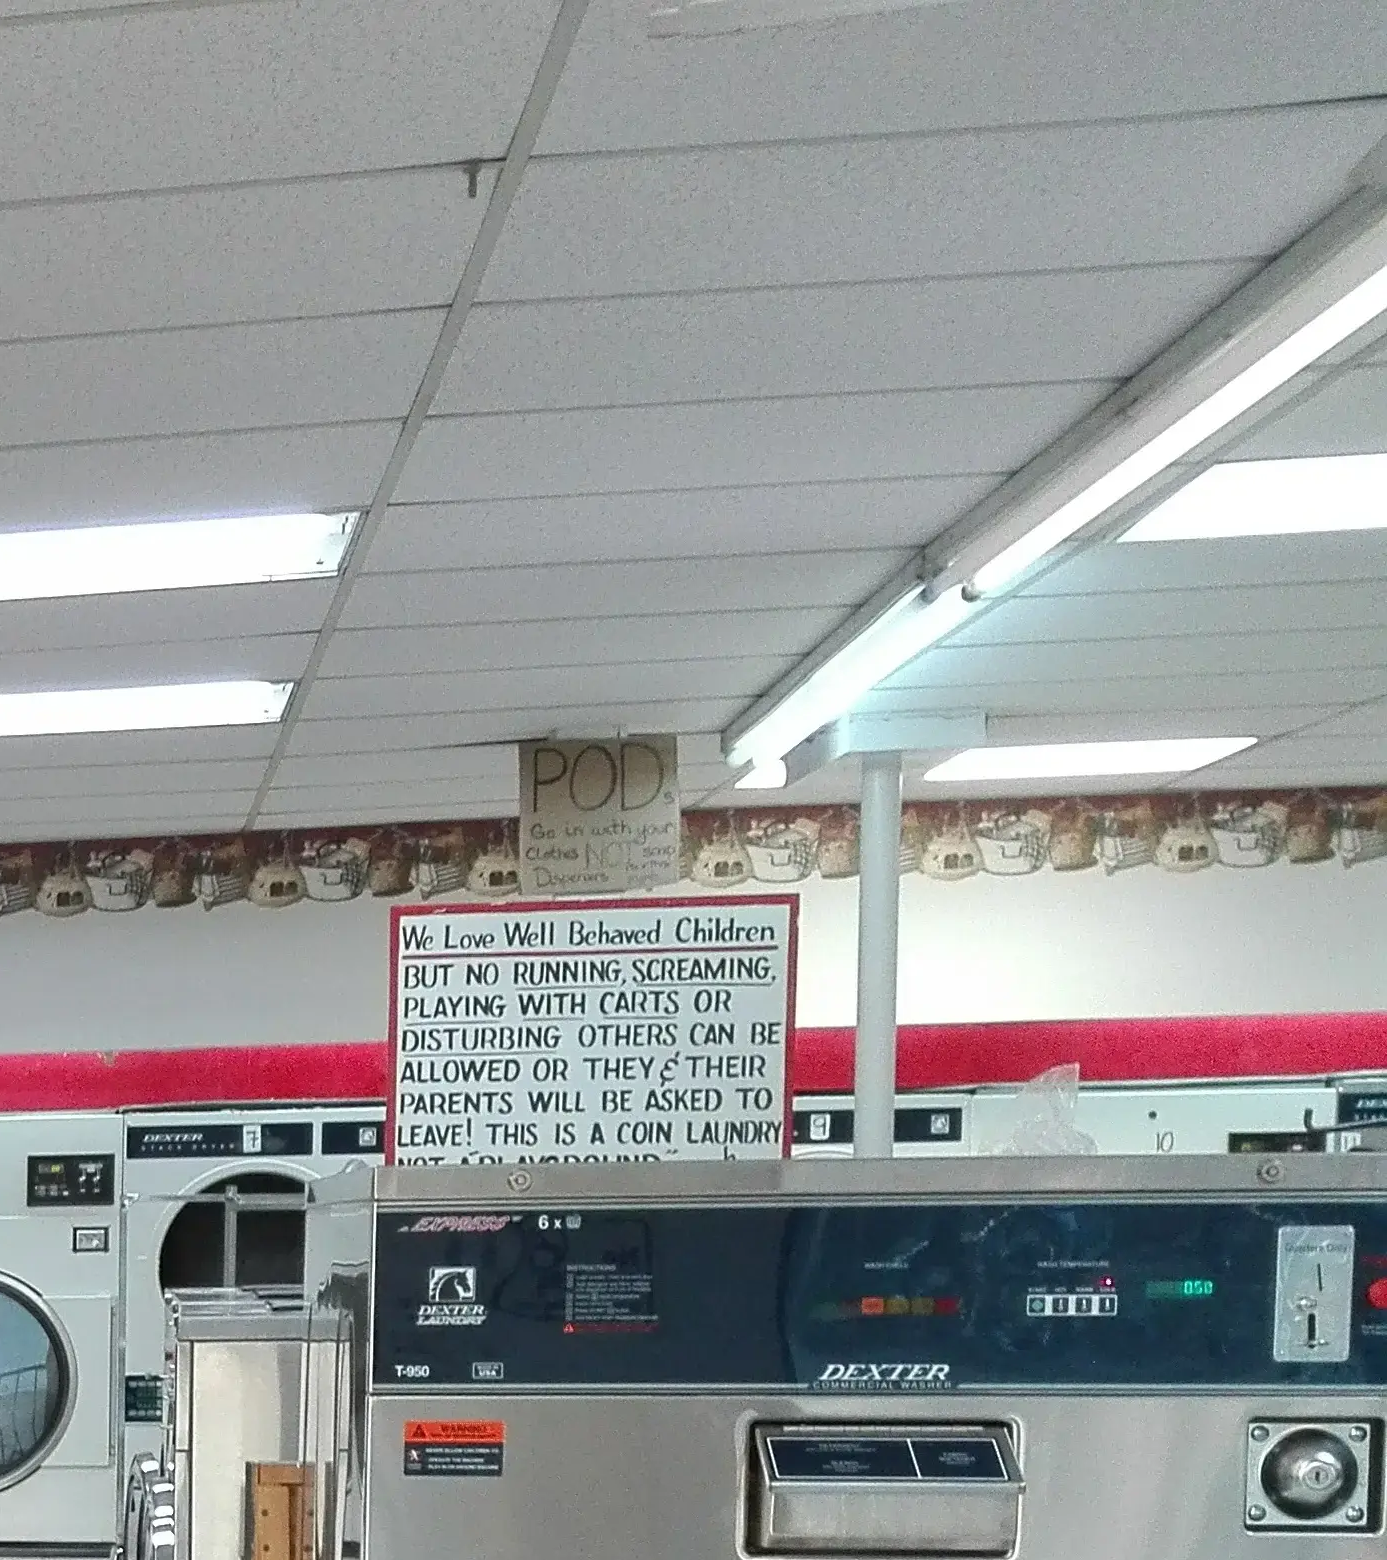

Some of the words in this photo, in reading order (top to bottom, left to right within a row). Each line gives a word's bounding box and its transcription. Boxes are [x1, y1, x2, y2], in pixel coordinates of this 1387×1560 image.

[402, 924, 434, 950] We
[444, 924, 495, 949] Love
[504, 921, 555, 948] Well
[569, 919, 661, 946] Behaved
[675, 916, 775, 943] Children
[403, 964, 455, 989] BUT
[465, 962, 499, 986] NO
[513, 960, 628, 986] RUNNING,
[632, 956, 777, 983] SCREAMING,
[403, 994, 507, 1019] PLAYING
[518, 992, 586, 1016] WITH
[599, 989, 680, 1015] CARTS
[693, 989, 732, 1014] OR
[401, 1026, 563, 1052] DISTURBING
[578, 1024, 678, 1048] OTHERS
[689, 1022, 735, 1046] CAN
[750, 1021, 782, 1046] BE
[400, 1059, 521, 1084] ALLOWED
[532, 1058, 569, 1082] OR
[583, 1056, 655, 1080] THEY
[685, 1055, 767, 1078] THEIR
[399, 1091, 514, 1114] PARENTS
[527, 1090, 586, 1113] WILL
[601, 1089, 633, 1113] BE
[645, 1087, 723, 1112] ASKED
[735, 1087, 773, 1110] TO
[397, 1117, 472, 1147] LEAVE!
[486, 1123, 538, 1146] THIS
[554, 1122, 576, 1146] IS
[590, 1122, 605, 1145] A
[617, 1121, 673, 1145] COIN
[686, 1120, 782, 1145] LAUNDRY
[813, 1115, 827, 1136] 9
[142, 1132, 204, 1142] DEXTER
[245, 1129, 259, 1149] 7
[1155, 1132, 1174, 1152] 10
[410, 1215, 511, 1232] EXPRESS
[538, 1215, 549, 1230] 6
[553, 1219, 562, 1229] x
[416, 1315, 487, 1325] LAUNDRY
[418, 1305, 486, 1315] DEXTER
[395, 1365, 430, 1378] T-950
[818, 1363, 950, 1381] DEXTER
[812, 1381, 894, 1390] COMMERCIAL
[900, 1381, 952, 1390] WASHER
